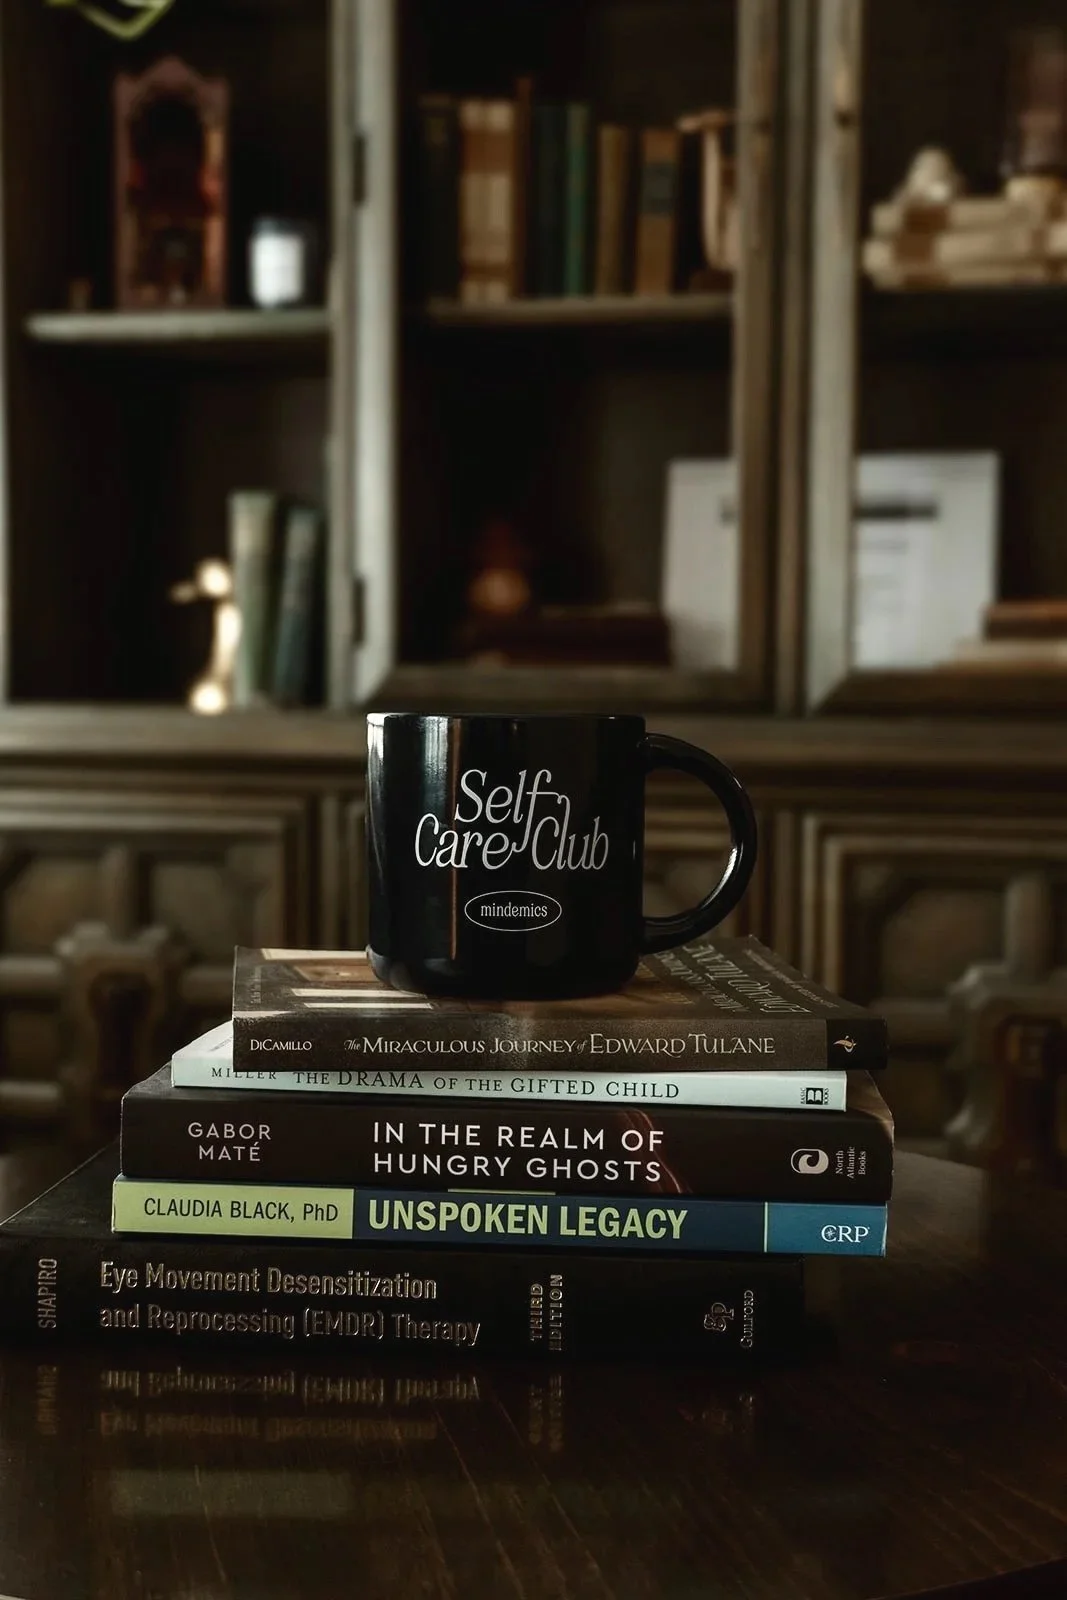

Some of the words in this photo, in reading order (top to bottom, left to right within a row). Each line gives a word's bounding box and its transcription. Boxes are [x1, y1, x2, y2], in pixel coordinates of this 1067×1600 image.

[454, 768, 559, 853] Self
[414, 812, 511, 870] Care
[531, 794, 609, 871] Club
[480, 901, 548, 918] mindemics
[344, 1038, 362, 1052] The
[362, 1036, 486, 1054] MIRACULOUS
[488, 1037, 577, 1054] JOURNEY
[576, 1039, 589, 1053] of
[589, 1033, 686, 1058] EDWARD
[687, 1033, 776, 1054] TULANE
[293, 1071, 331, 1085] THE
[338, 1071, 425, 1089] DRAMA
[433, 1076, 458, 1090] OF
[464, 1077, 503, 1092] THE
[510, 1077, 596, 1096] GIFTED
[605, 1080, 680, 1099] CHILD
[187, 1121, 272, 1142] GABOR
[373, 1121, 405, 1144] IN
[418, 1123, 482, 1147] THE
[497, 1125, 605, 1151] REALM
[621, 1129, 665, 1152] OF
[198, 1141, 262, 1162] MATÉ
[373, 1152, 512, 1178] HUNGRY
[526, 1157, 662, 1183] GHOSTS
[835, 1149, 845, 1175] North
[846, 1146, 856, 1180] Atlantic
[857, 1150, 867, 1176] Books
[143, 1196, 223, 1218] CLAUDIA
[229, 1200, 296, 1224] BLACK,
[302, 1202, 340, 1222] PhD
[368, 1199, 549, 1236] UNSPOKEN
[559, 1205, 689, 1240] LEGACY
[37, 1257, 58, 1329] SHAPIRO
[100, 1260, 138, 1294] Eye
[145, 1262, 261, 1293] Movement
[267, 1267, 438, 1300] Desensitization
[99, 1303, 140, 1329] and
[147, 1304, 295, 1340] Reprocessing
[303, 1306, 385, 1340] (EMDR)
[391, 1313, 482, 1347] Therapy
[529, 1283, 543, 1343] THIRD
[548, 1273, 563, 1351] EDITION
[740, 1289, 754, 1348] GUILFORD
